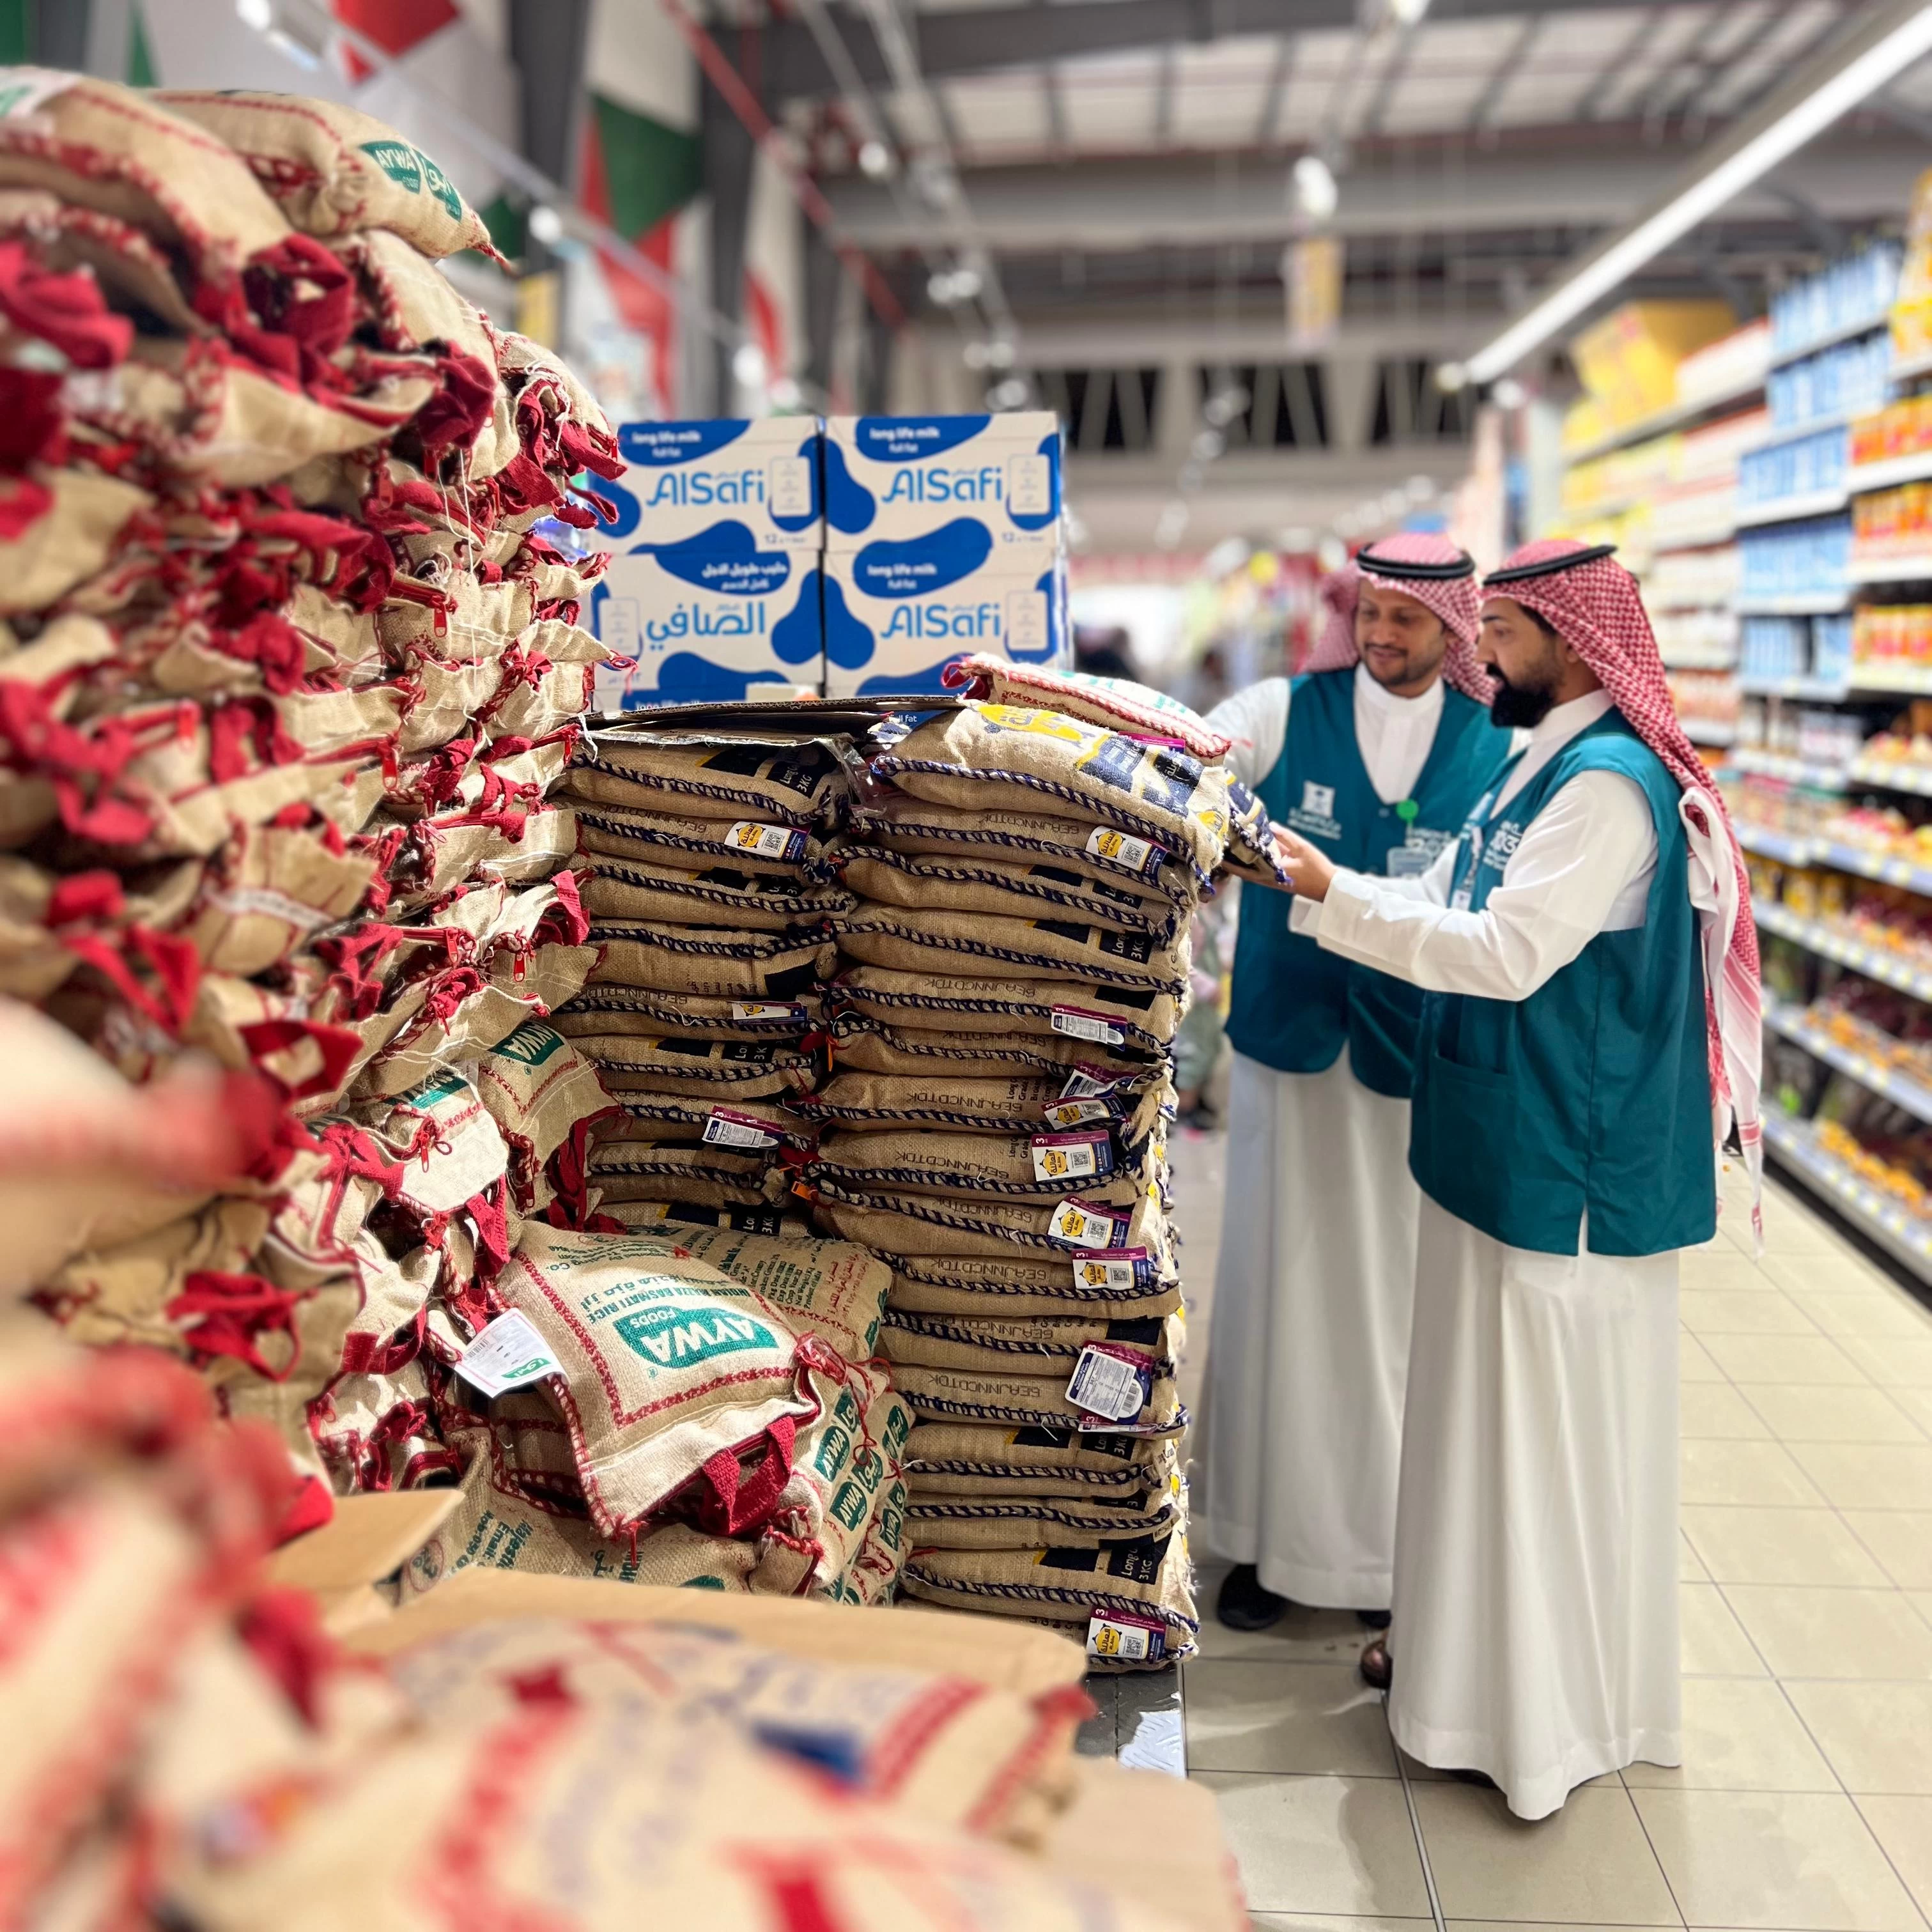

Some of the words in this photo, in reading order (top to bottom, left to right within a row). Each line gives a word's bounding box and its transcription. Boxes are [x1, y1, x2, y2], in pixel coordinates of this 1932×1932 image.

[375, 149, 416, 171] AYWA
[632, 431, 656, 445] long
[657, 431, 676, 443] life
[677, 429, 702, 442] milk
[869, 428, 894, 442] long
[895, 427, 915, 439] life
[916, 426, 940, 439] milk
[645, 470, 765, 507] AlSafi
[881, 467, 1003, 503] AlSafi
[867, 564, 892, 578] long
[893, 564, 911, 576] life
[912, 563, 938, 575] milk
[645, 601, 765, 651] الصافي
[879, 603, 1001, 638] AlSafi
[1048, 1150, 1057, 1173] العائلة
[1065, 1212, 1076, 1233] العائلة
[619, 1288, 674, 1308] BASMATI
[587, 1302, 619, 1324] RICE
[630, 1306, 677, 1327] FOODS
[640, 1315, 757, 1363] AYWA
[821, 1428, 847, 1478] AYWA
[838, 1486, 863, 1527] AYWA
[1121, 1554, 1139, 1576] Long
[1139, 1559, 1152, 1580] 3KG
